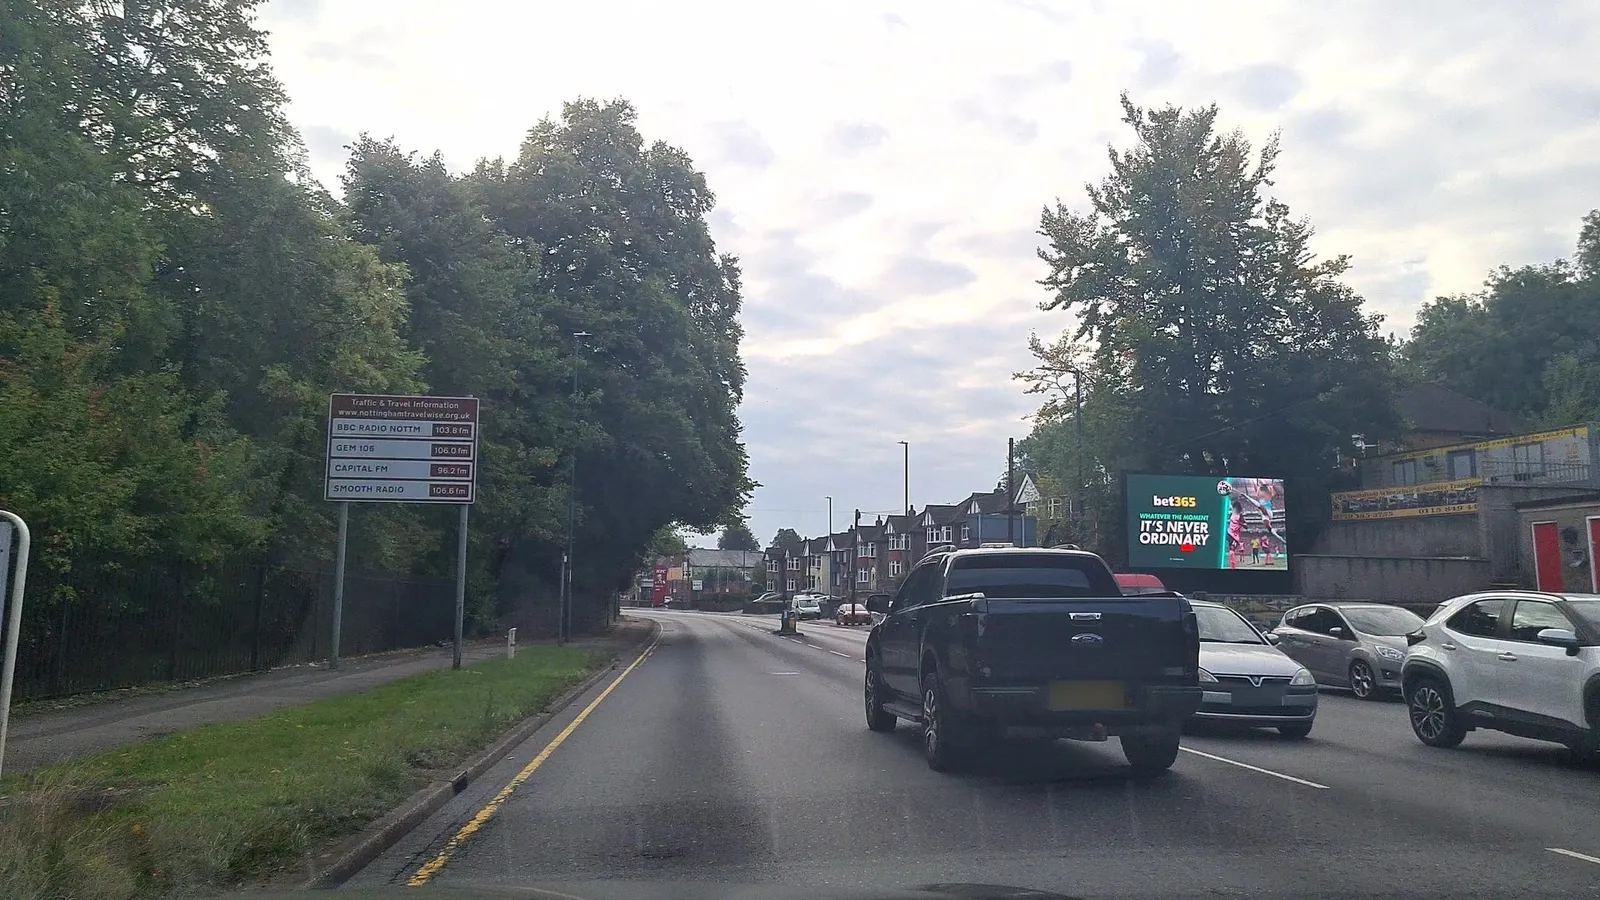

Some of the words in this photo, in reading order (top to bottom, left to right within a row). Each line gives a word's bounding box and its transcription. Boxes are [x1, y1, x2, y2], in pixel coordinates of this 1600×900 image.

[338, 410, 470, 420] www.nottinghamtravelwise.org.uk
[335, 464, 372, 472] CAPITAL
[1154, 495, 1196, 507] bet365
[1140, 521, 1163, 532] IT'S
[1167, 521, 1208, 533] NEVER
[1139, 532, 1209, 546] ORDINARY
